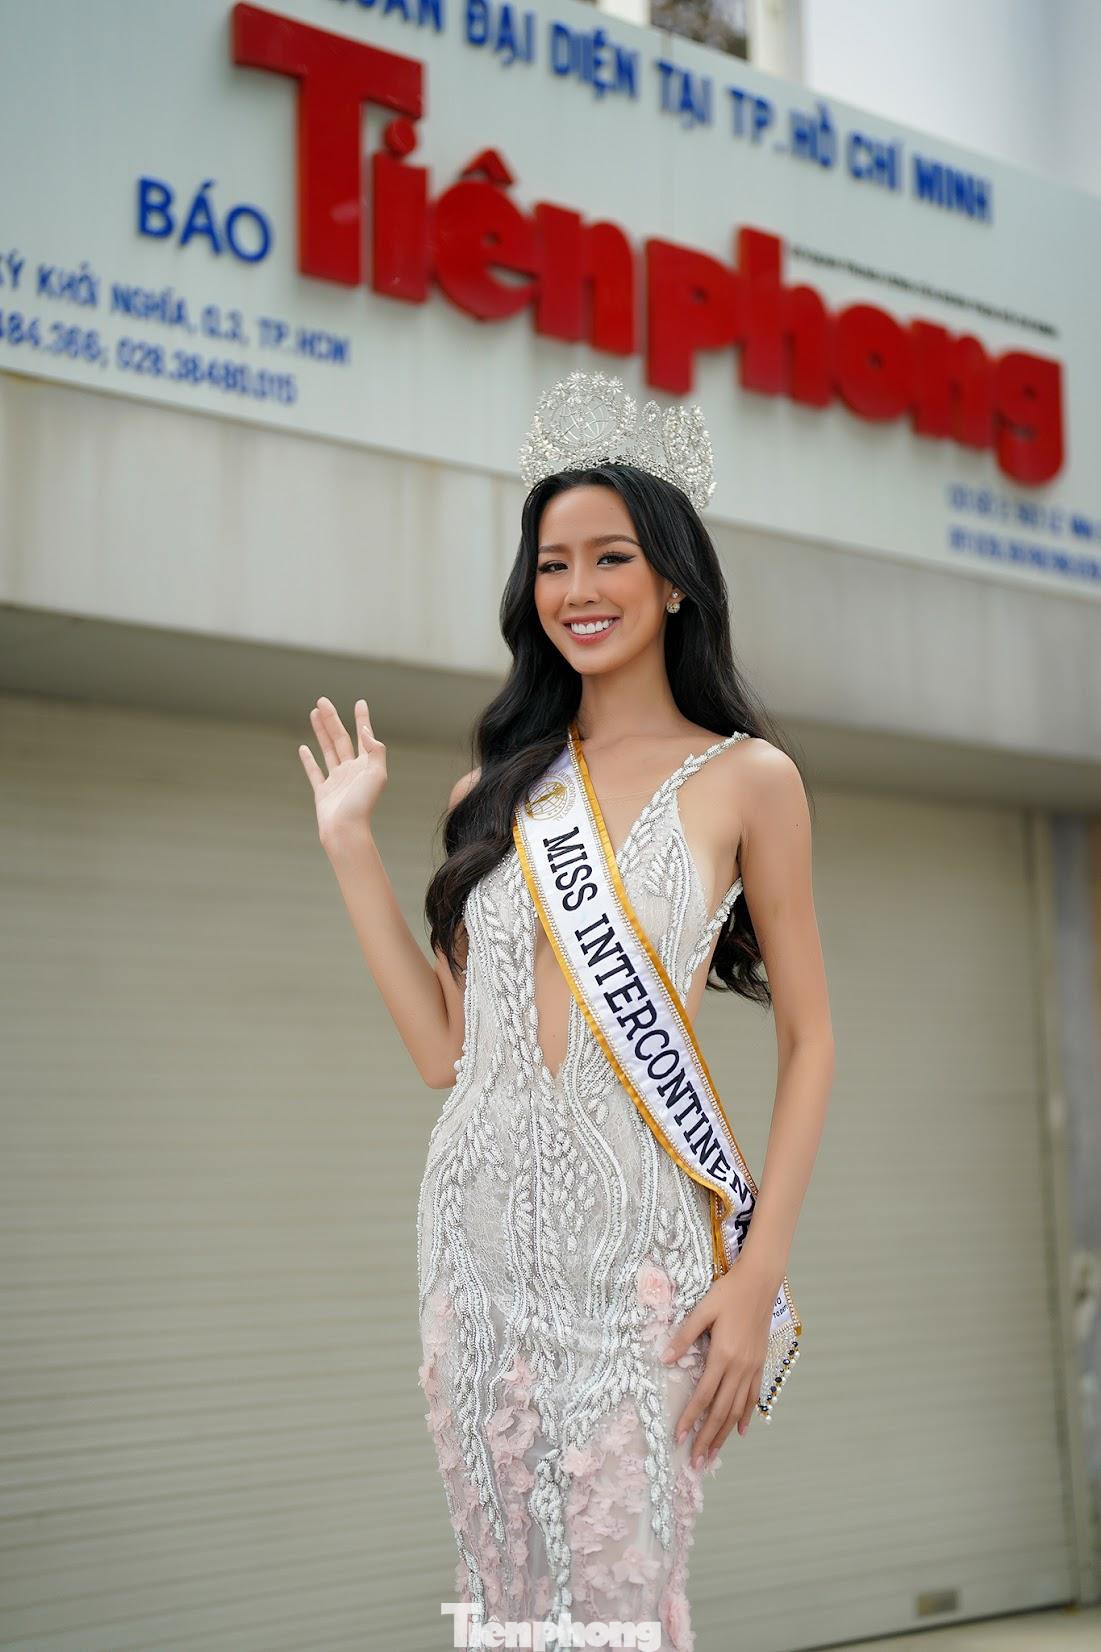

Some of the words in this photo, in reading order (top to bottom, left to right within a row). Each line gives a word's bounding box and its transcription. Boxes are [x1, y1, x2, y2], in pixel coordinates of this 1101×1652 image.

[138, 176, 271, 262] BÁO
[337, 0, 443, 33] AN
[465, 0, 534, 66] ĐẠI
[551, 21, 638, 101] DIỆN
[656, 58, 711, 128] TẠI
[848, 131, 901, 190] CHÍ
[912, 153, 992, 222] MINH
[543, 827, 598, 912] MISS
[575, 913, 756, 1253] INTERCONTINEN
